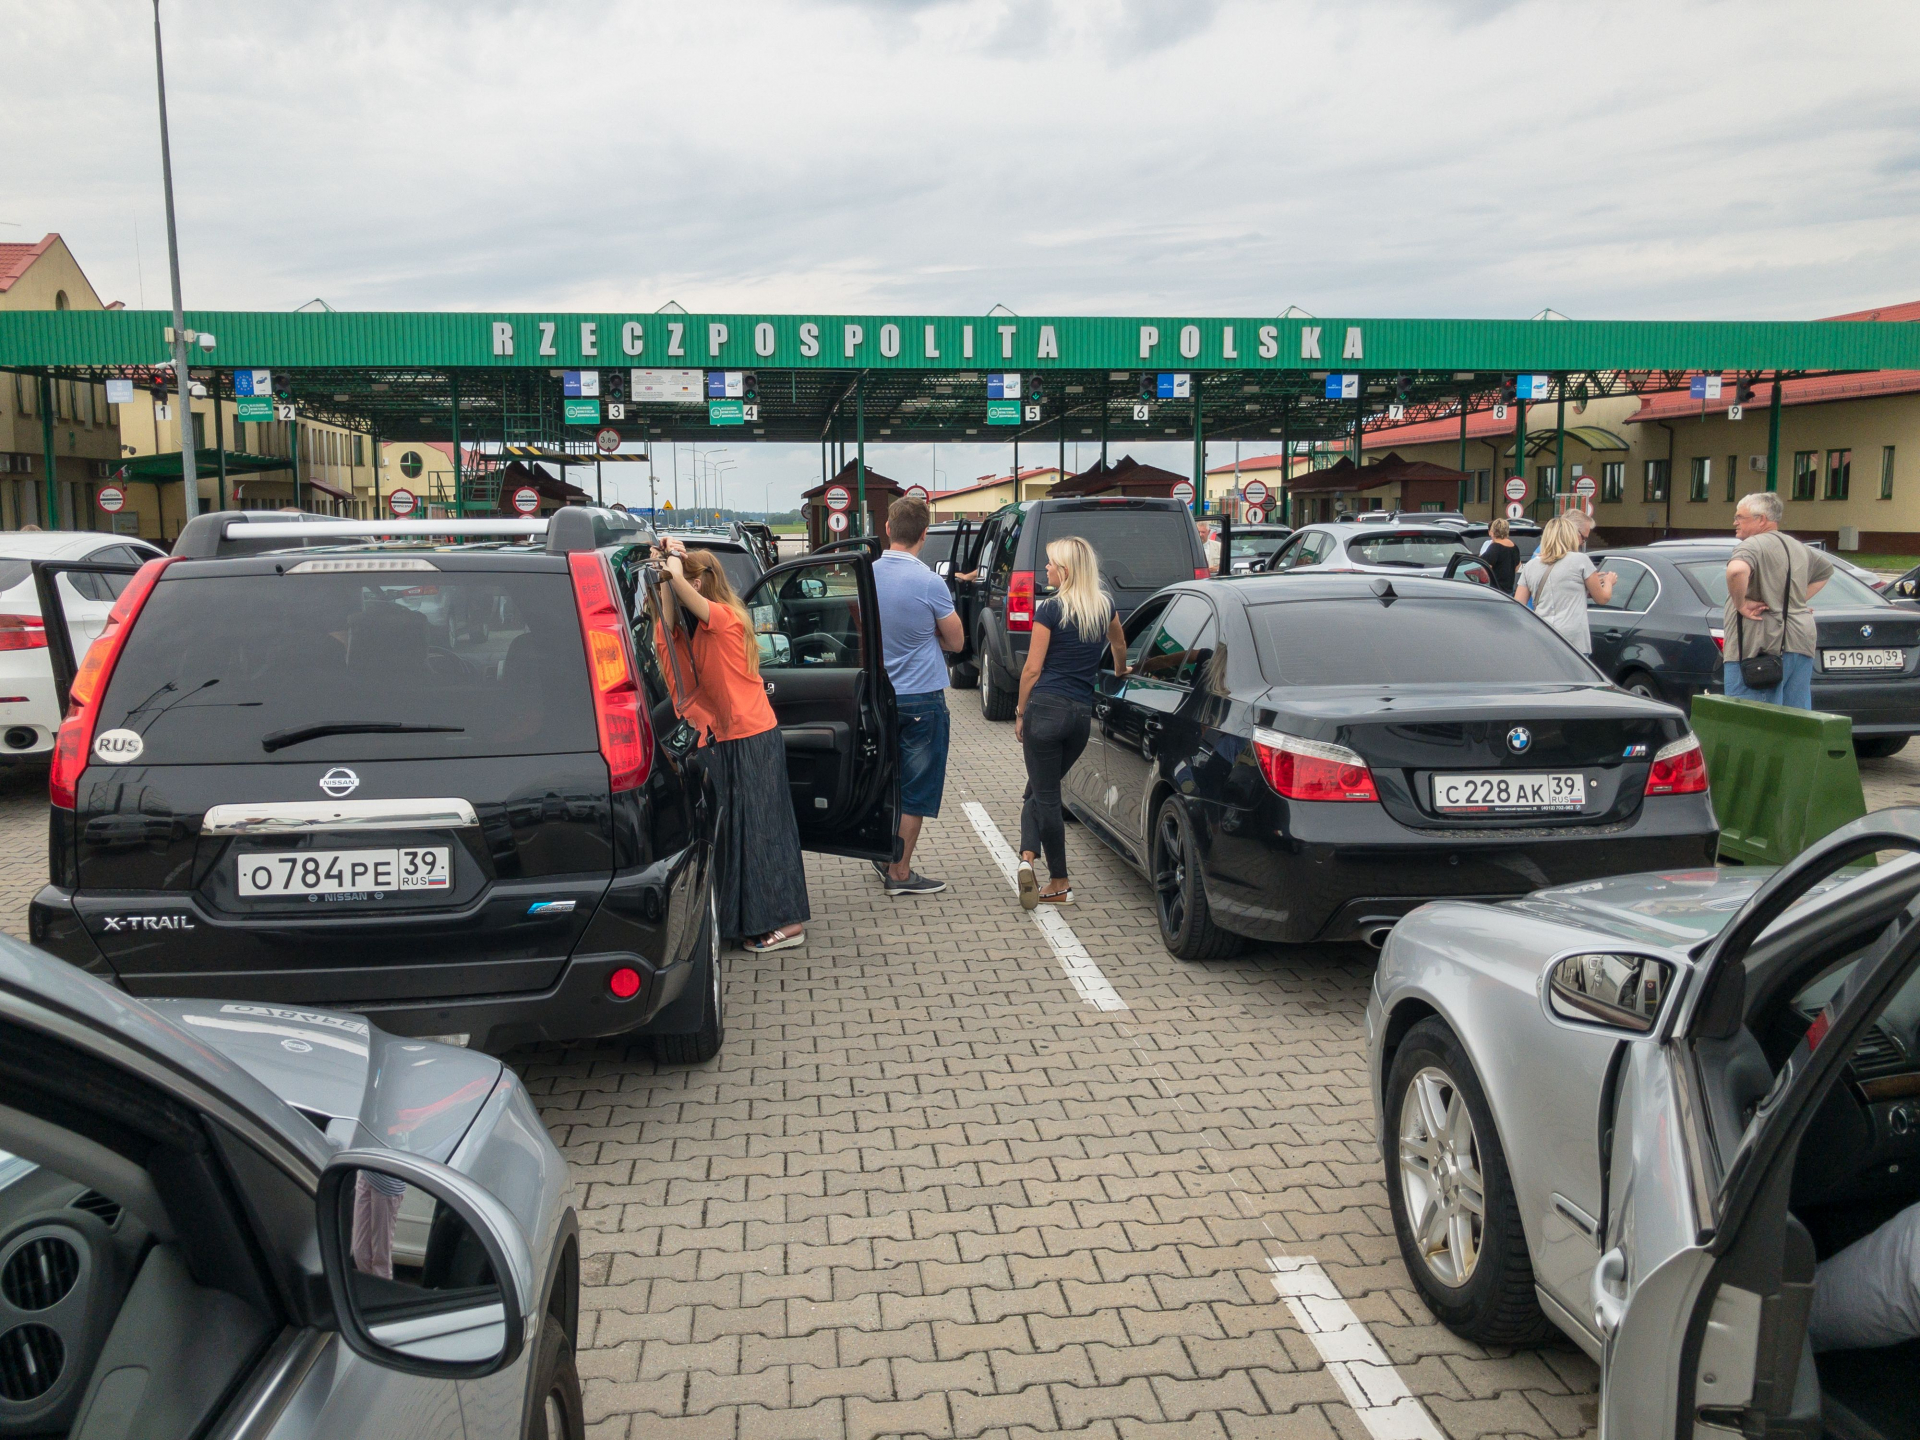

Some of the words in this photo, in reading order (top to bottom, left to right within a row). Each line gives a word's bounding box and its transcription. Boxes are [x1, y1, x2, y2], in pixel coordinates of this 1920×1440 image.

[492, 322, 1058, 359] RZECZPOSPOLITA
[1139, 325, 1363, 359] POLSKA
[161, 406, 166, 420] 1
[283, 405, 292, 419] 2
[612, 405, 621, 418] 3
[745, 406, 755, 419] 4
[1029, 407, 1037, 420] 5
[1137, 406, 1145, 419] 6
[1393, 406, 1401, 418] 7
[1496, 406, 1504, 418] 8
[1731, 406, 1740, 419] 9
[99, 738, 139, 752] RUS
[1552, 777, 1575, 795] 39
[404, 851, 437, 875] 39
[402, 876, 427, 886] RUS
[324, 892, 368, 902] NISSAN
[103, 915, 195, 931] X-TRAIL
